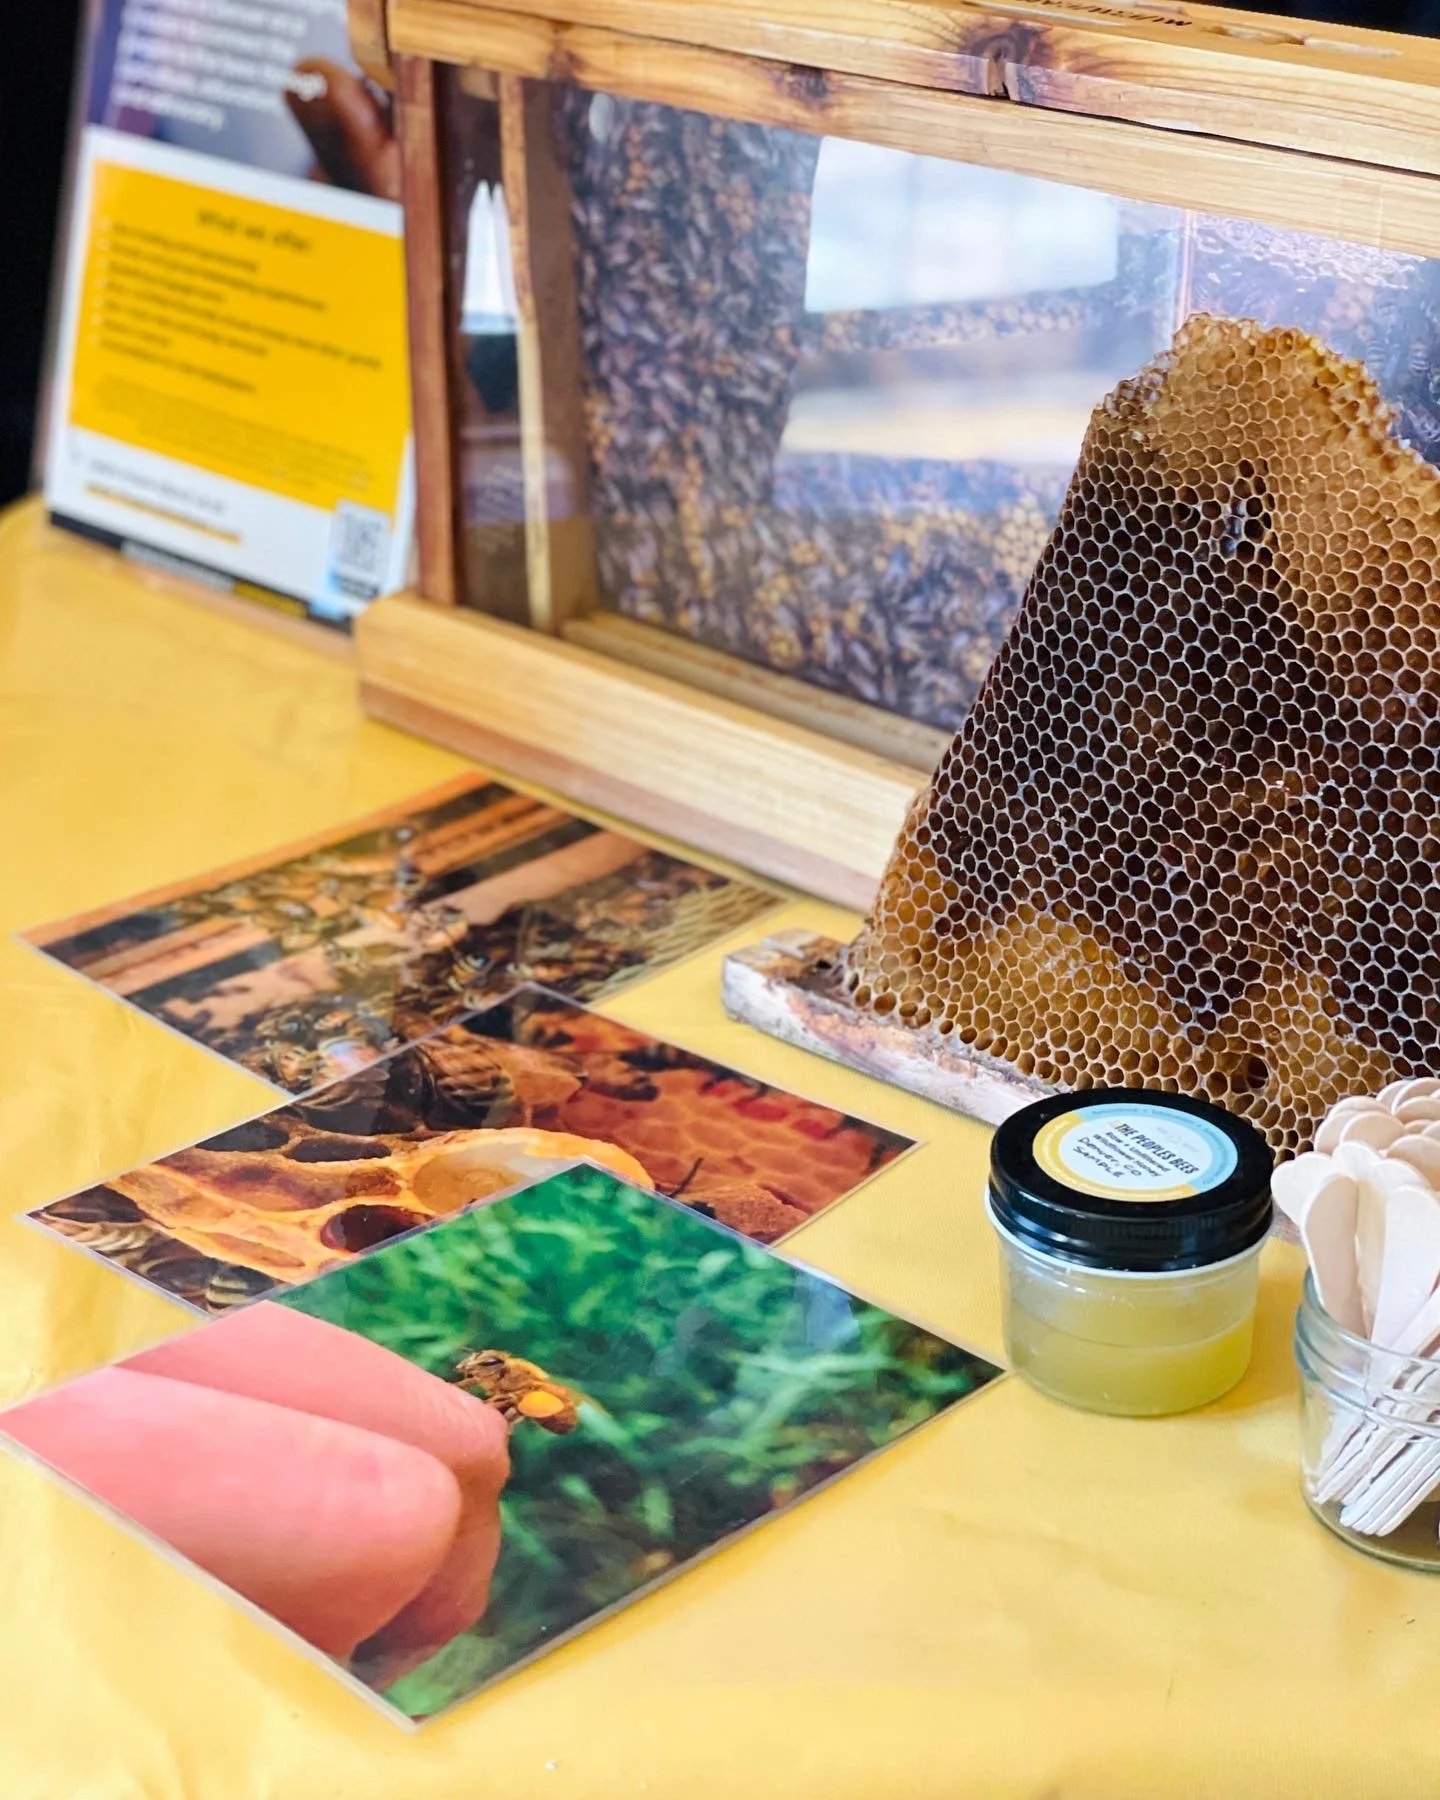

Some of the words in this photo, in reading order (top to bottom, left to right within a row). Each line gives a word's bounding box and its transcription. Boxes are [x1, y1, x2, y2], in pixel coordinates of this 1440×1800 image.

[1114, 1123, 1138, 1137] THE
[1131, 1133, 1176, 1159] PEOPLES
[1169, 1157, 1200, 1175] BEES
[1123, 1163, 1142, 1177] CO
